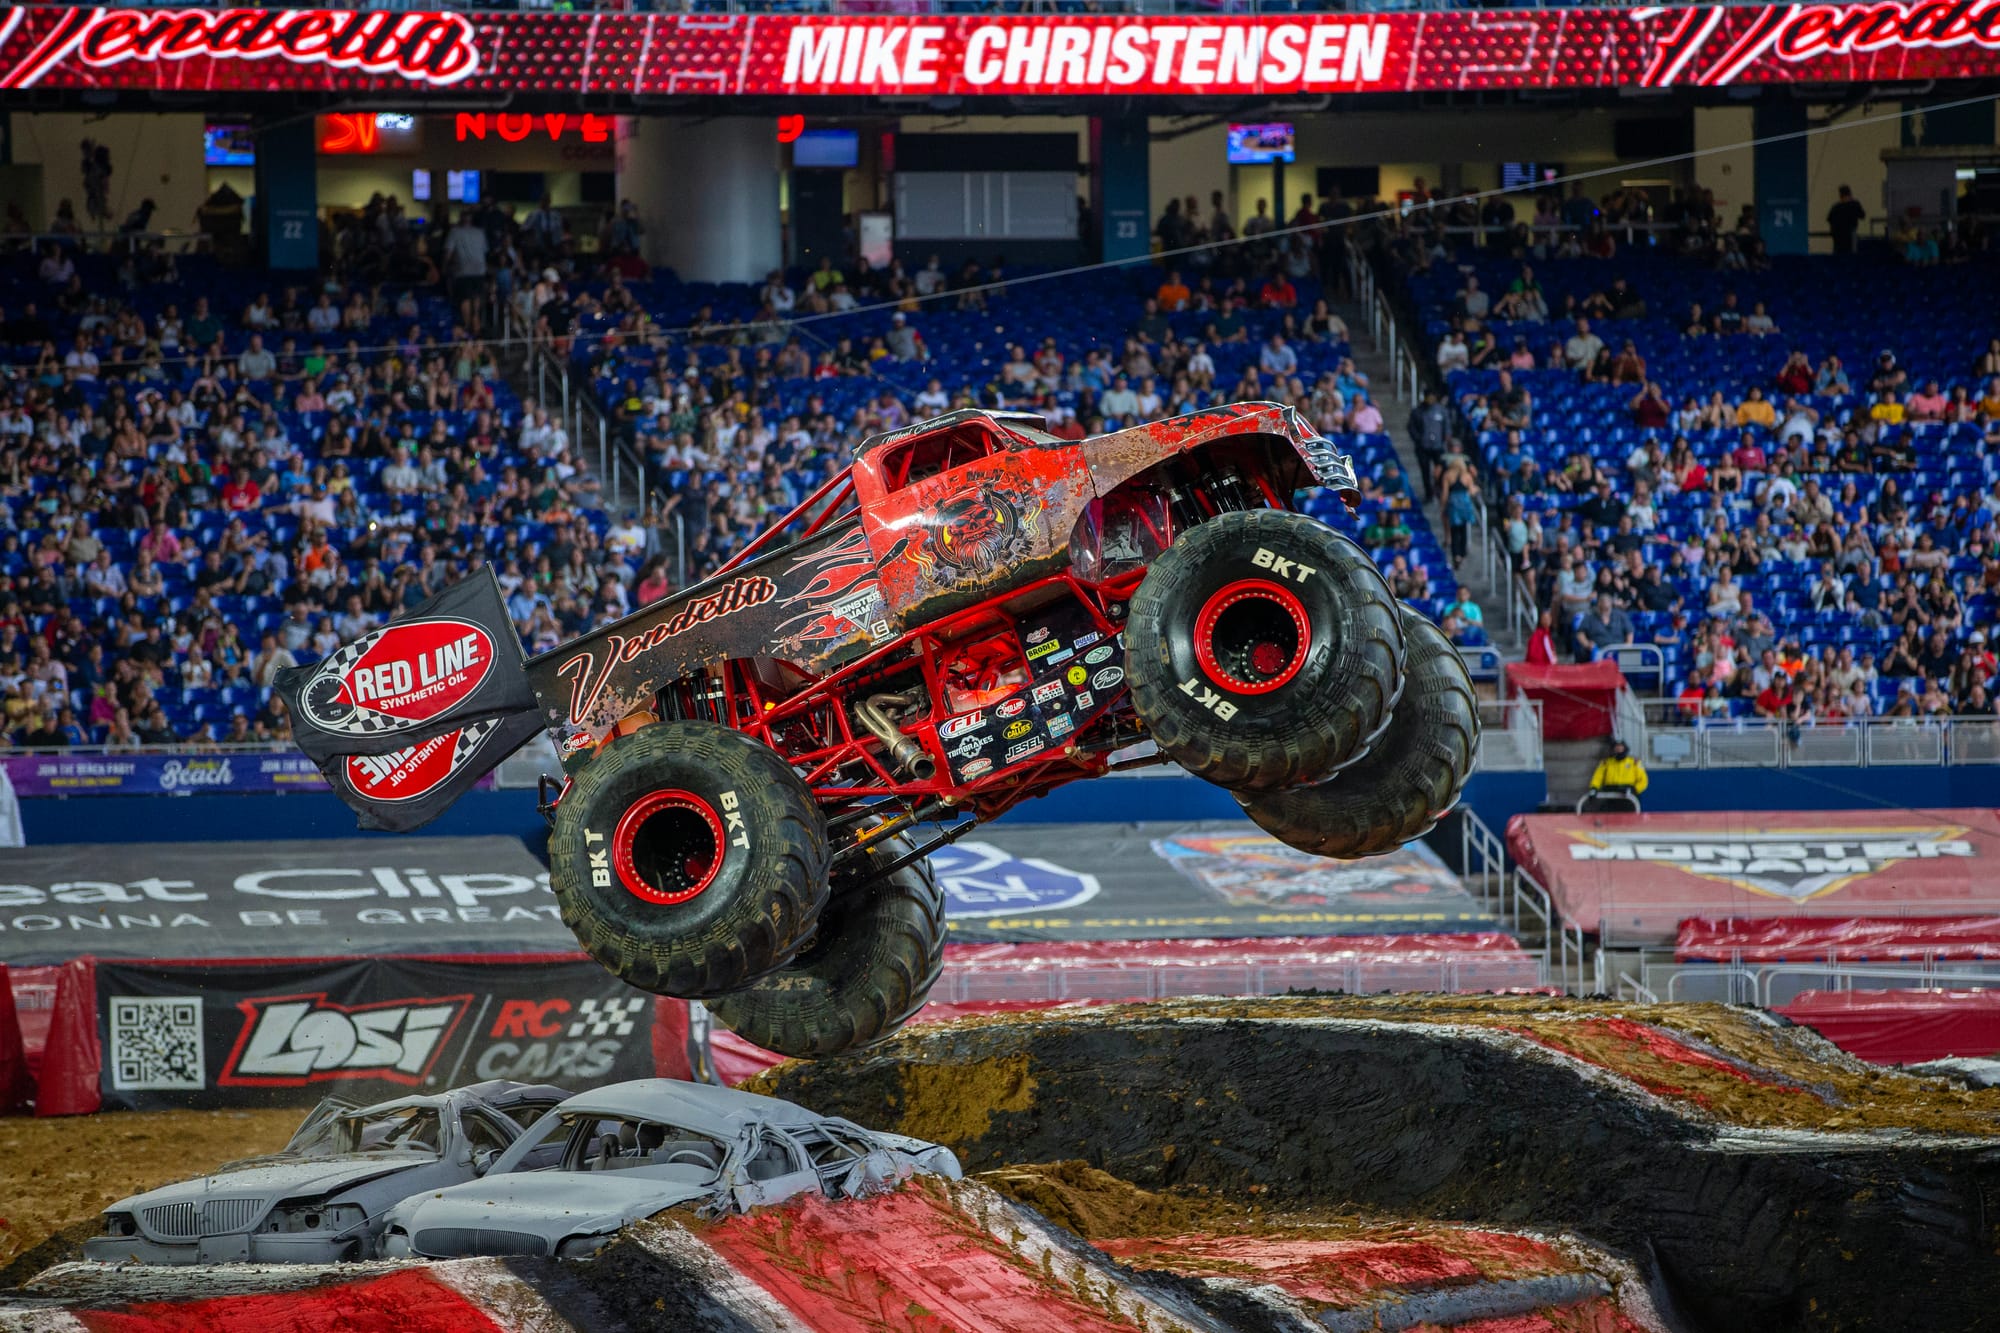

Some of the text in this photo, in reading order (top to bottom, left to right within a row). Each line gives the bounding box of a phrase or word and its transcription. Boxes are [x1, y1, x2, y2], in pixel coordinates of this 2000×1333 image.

[782, 24, 1391, 84] MIKE CHRISTENSEN
[282, 221, 304, 239] 22
[1251, 547, 1317, 584] BKT
[832, 591, 882, 619] MONSTER
[849, 604, 872, 619] JAM
[557, 576, 779, 726] Vendetta
[1027, 640, 1057, 657] BRODIX
[354, 632, 479, 703] RED LINE
[1095, 670, 1121, 689] Gates
[380, 672, 468, 710] SYNTHETIC OIL
[1177, 678, 1239, 721] BKT
[950, 711, 981, 733] FTI
[1007, 722, 1031, 738] CALLIES
[1005, 736, 1044, 759] JESEL
[160, 758, 235, 789] Beach
[719, 790, 750, 850] BKT
[584, 827, 612, 888] BKT
[1568, 840, 1977, 861] MONSTER
[1692, 857, 1871, 874] JAM
[0, 912, 211, 931] ONNA
[238, 909, 328, 928] BE
[490, 998, 573, 1039] RC
[475, 1039, 624, 1081] CARS
